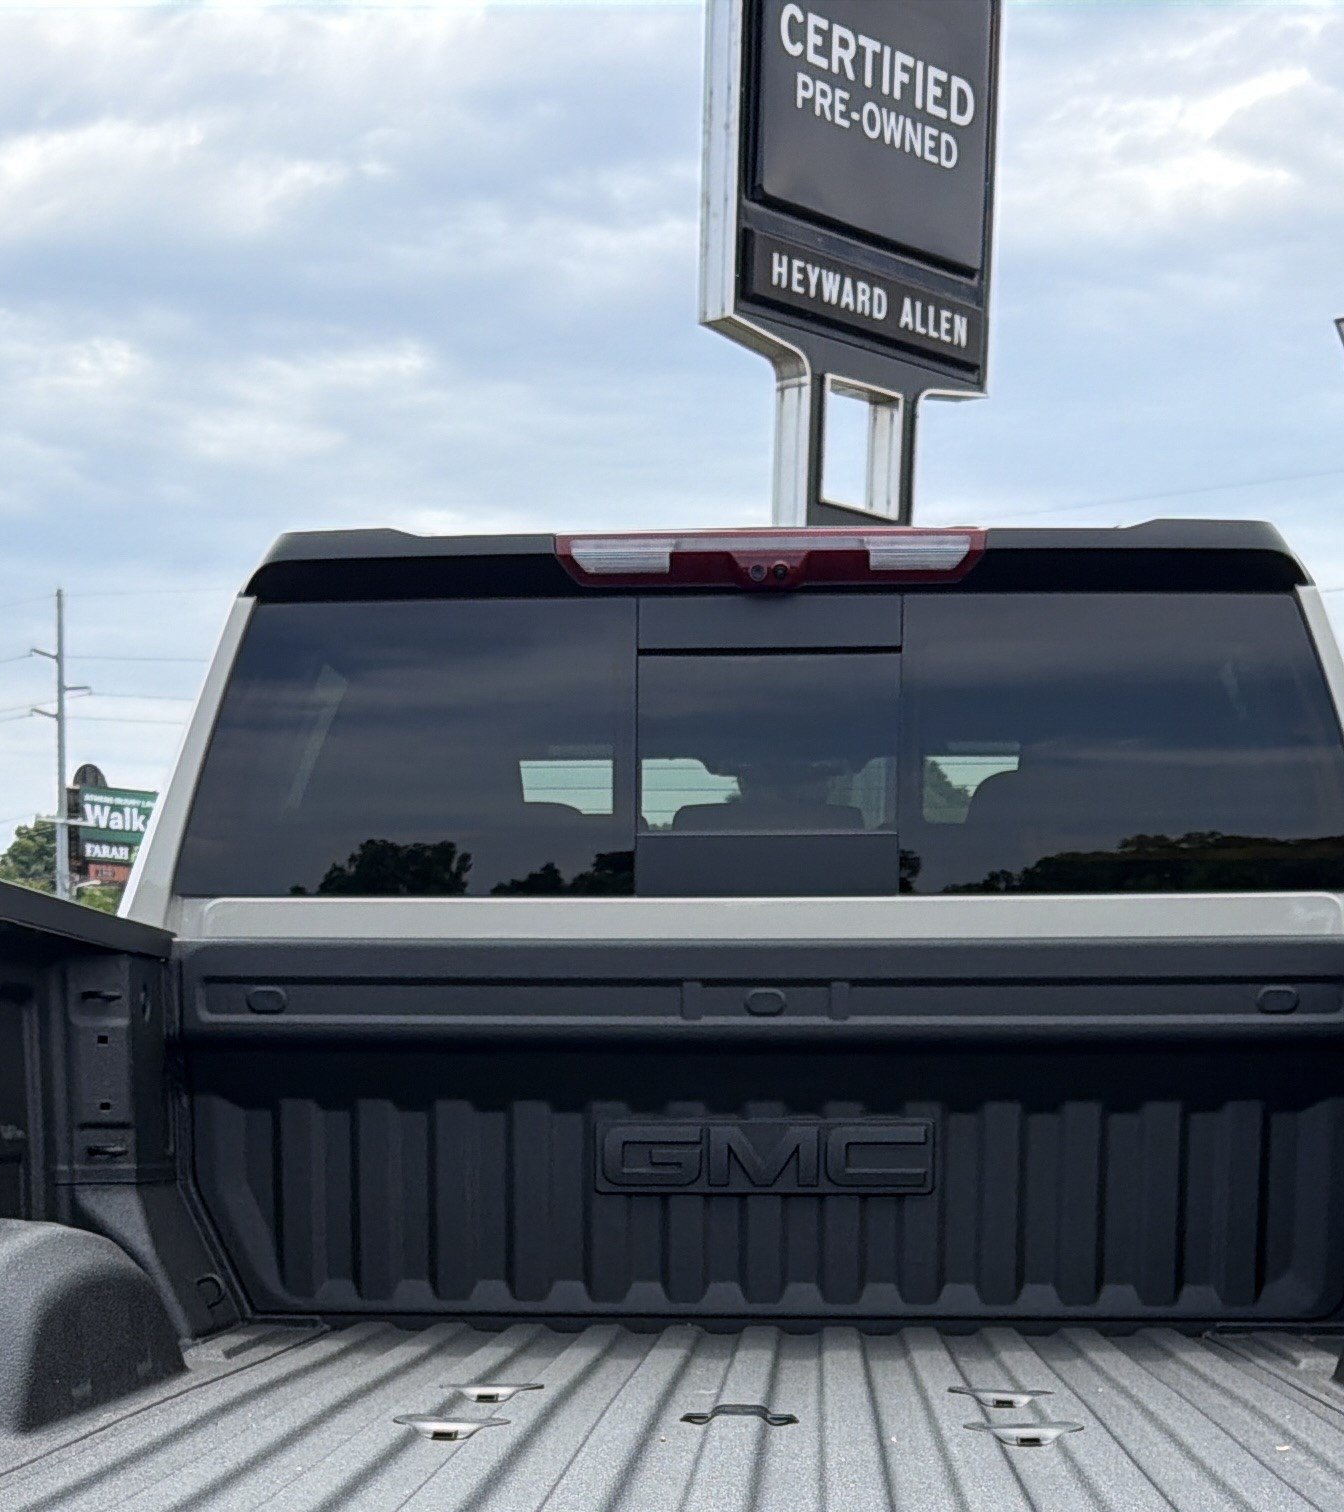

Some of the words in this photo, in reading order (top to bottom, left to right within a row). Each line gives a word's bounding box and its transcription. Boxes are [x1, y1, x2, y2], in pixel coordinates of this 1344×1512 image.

[779, 3, 976, 127] CERTIFIED
[796, 72, 959, 169] PRE-OWNED
[771, 251, 888, 320] HEYWARD
[899, 296, 968, 348] ALLEN
[83, 803, 149, 832] Walk
[602, 1124, 929, 1189] GMC
